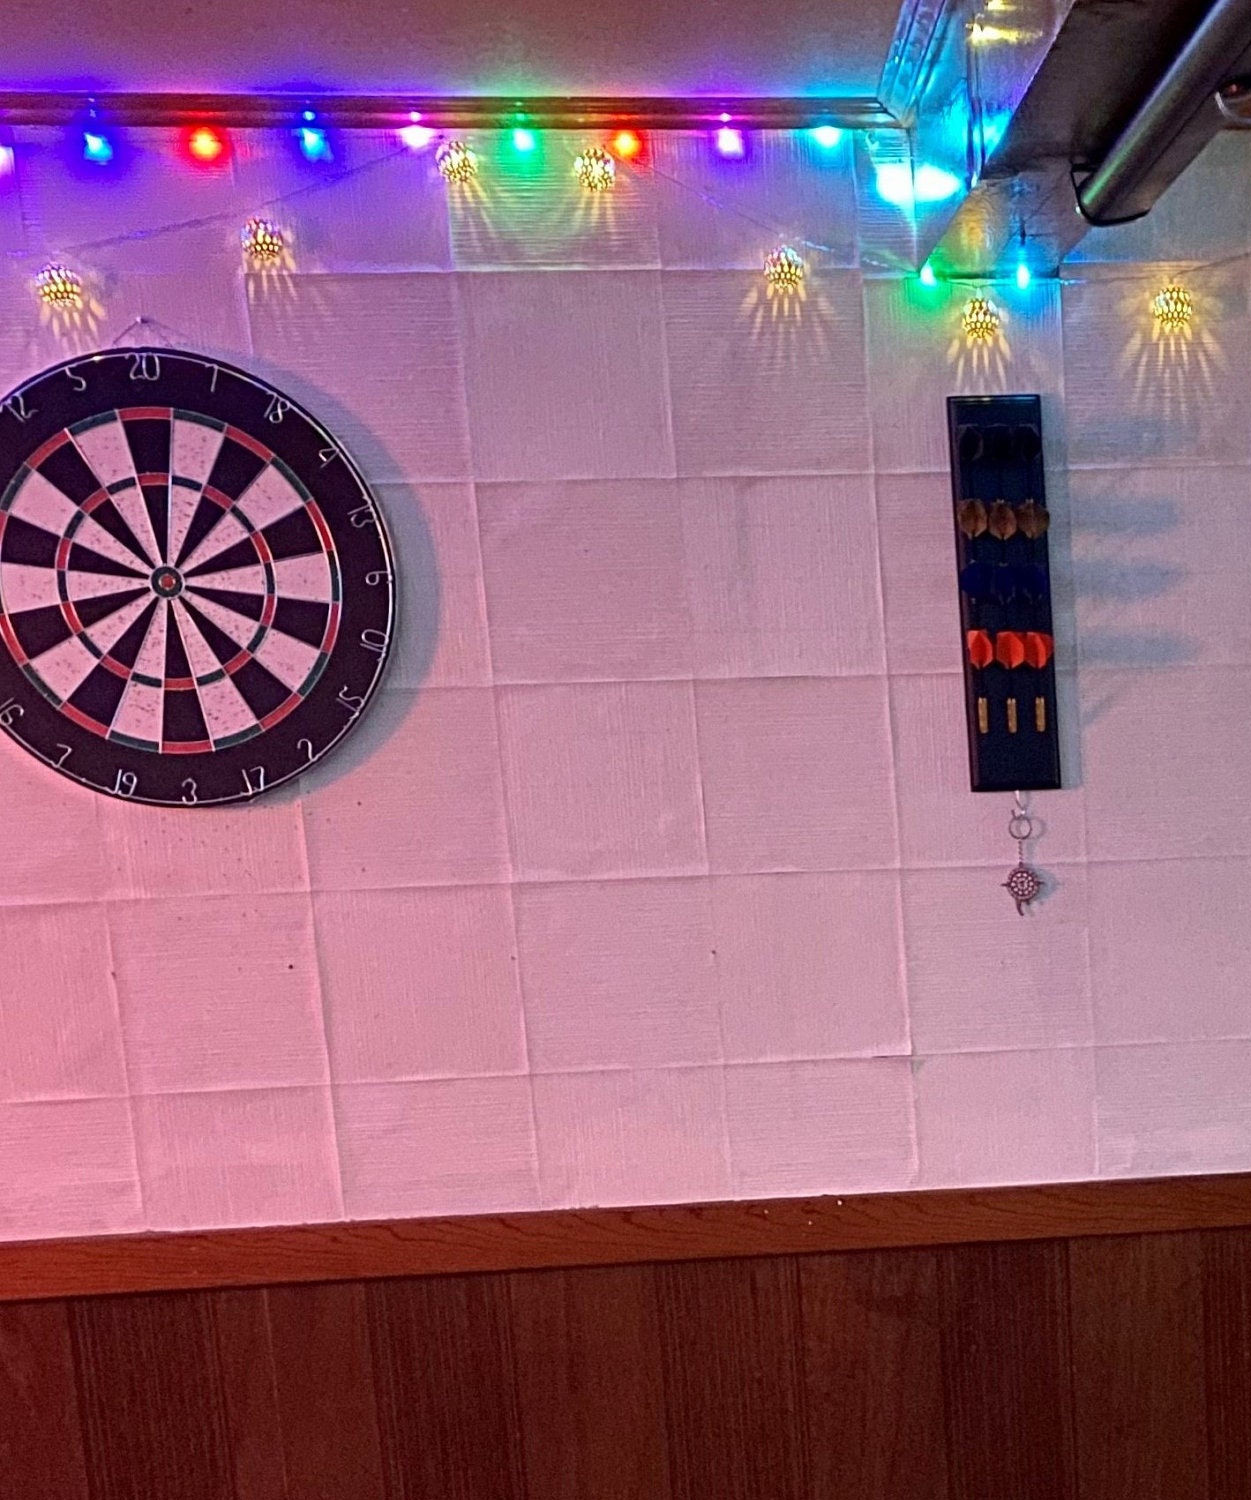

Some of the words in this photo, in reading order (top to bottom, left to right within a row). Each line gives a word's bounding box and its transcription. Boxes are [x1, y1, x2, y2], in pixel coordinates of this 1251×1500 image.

[64, 366, 86, 392] 5
[124, 352, 161, 381] 20
[204, 364, 218, 392] 1
[8, 393, 39, 423] 12
[262, 393, 291, 424] 18
[318, 447, 339, 468] 4
[346, 503, 378, 528] 13
[364, 569, 392, 587] 6
[359, 628, 389, 653] 10
[335, 685, 366, 719] 15
[51, 744, 73, 768] 7
[297, 737, 319, 762] 2
[111, 769, 138, 796] 19
[181, 778, 198, 804] 3
[240, 766, 266, 796] 17
